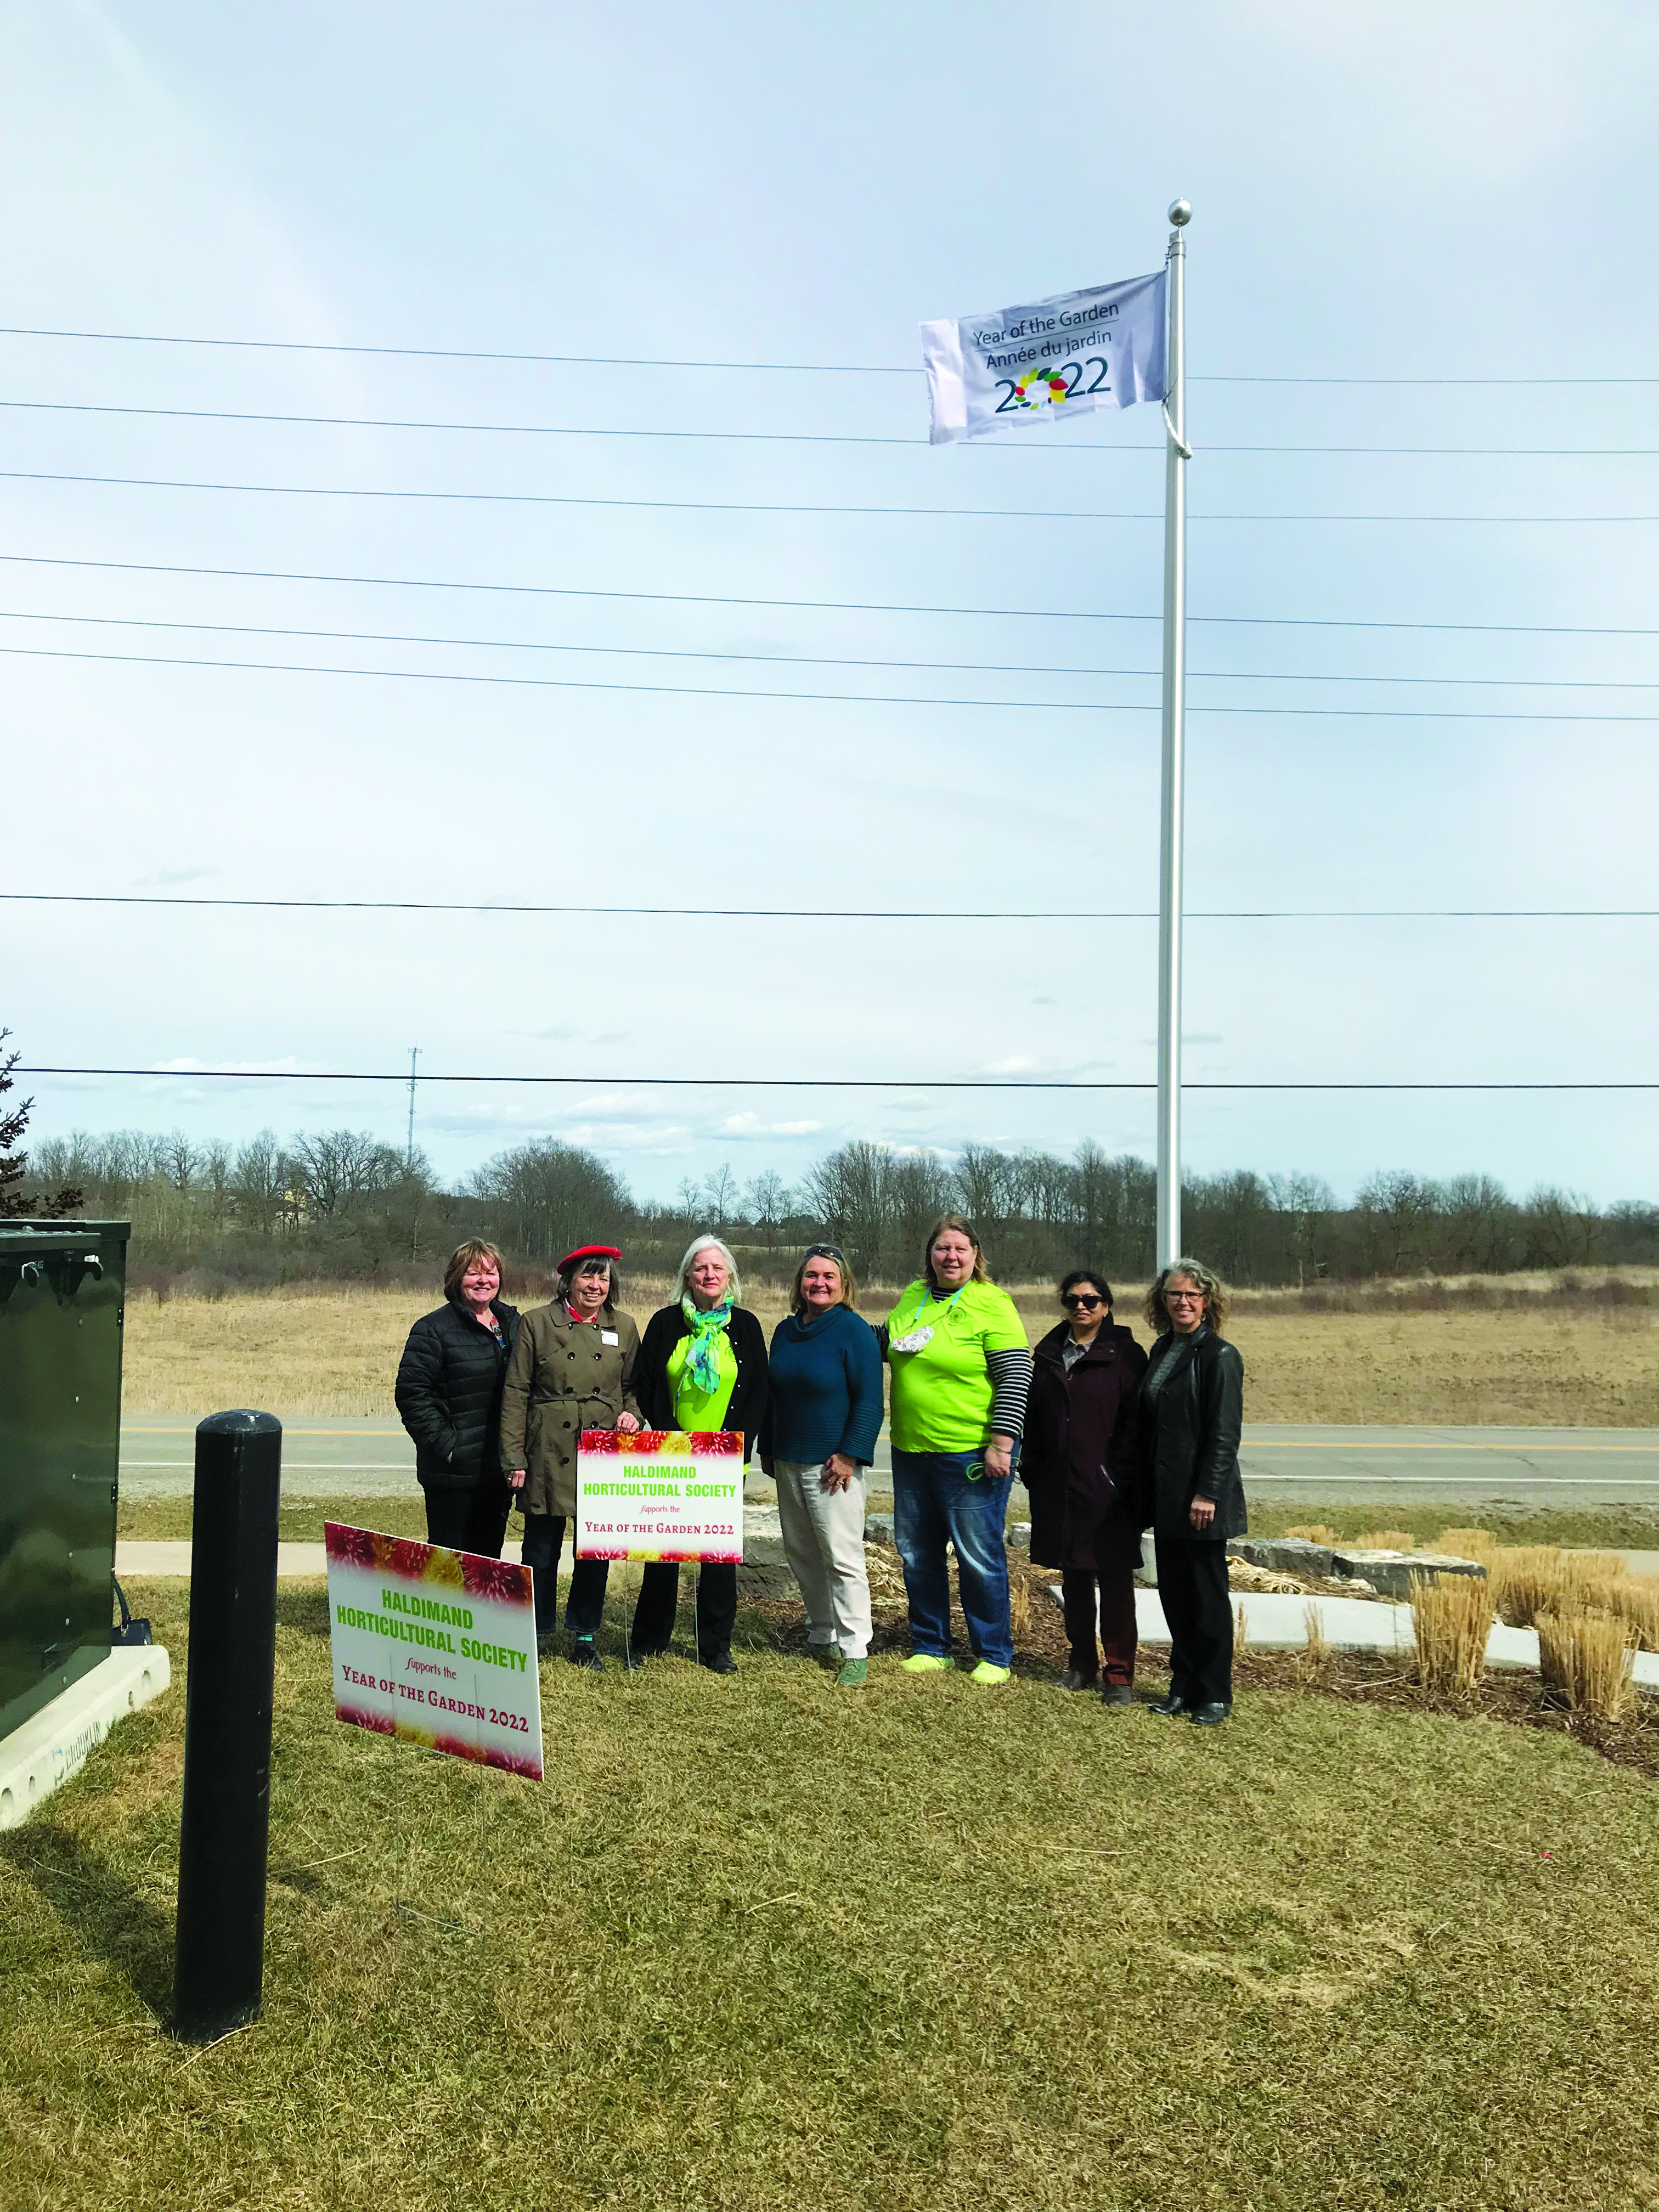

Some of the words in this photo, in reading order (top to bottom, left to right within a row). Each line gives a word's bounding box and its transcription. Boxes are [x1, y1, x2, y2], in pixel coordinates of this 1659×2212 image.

[973, 330, 1007, 346] Year
[1011, 320, 1026, 338] of
[1029, 317, 1056, 333] the
[1060, 303, 1119, 326] Garden
[986, 347, 1036, 369] Année
[1041, 341, 1062, 357] du
[1066, 330, 1111, 356] jardin
[623, 1465, 696, 1479] HALDIMAND
[584, 1483, 681, 1496] HORTICULTURAL
[685, 1484, 736, 1497] SOCIETY
[638, 1505, 668, 1515] supports
[585, 1521, 613, 1532] YEAR
[616, 1523, 630, 1532] OF
[633, 1524, 653, 1533] THE
[656, 1523, 701, 1534] GARDEN
[704, 1525, 734, 1534] 2022
[382, 1589, 473, 1629] HALDIMAND
[337, 1605, 456, 1654] HORTICULTURAL
[461, 1637, 527, 1672] SOCIETY
[404, 1657, 441, 1675] supports
[443, 1666, 457, 1680] the
[342, 1665, 376, 1689] YEAR
[379, 1678, 396, 1694] OF
[398, 1684, 424, 1703] THE
[428, 1690, 485, 1720] GARDEN
[489, 1708, 529, 1733] 2022
